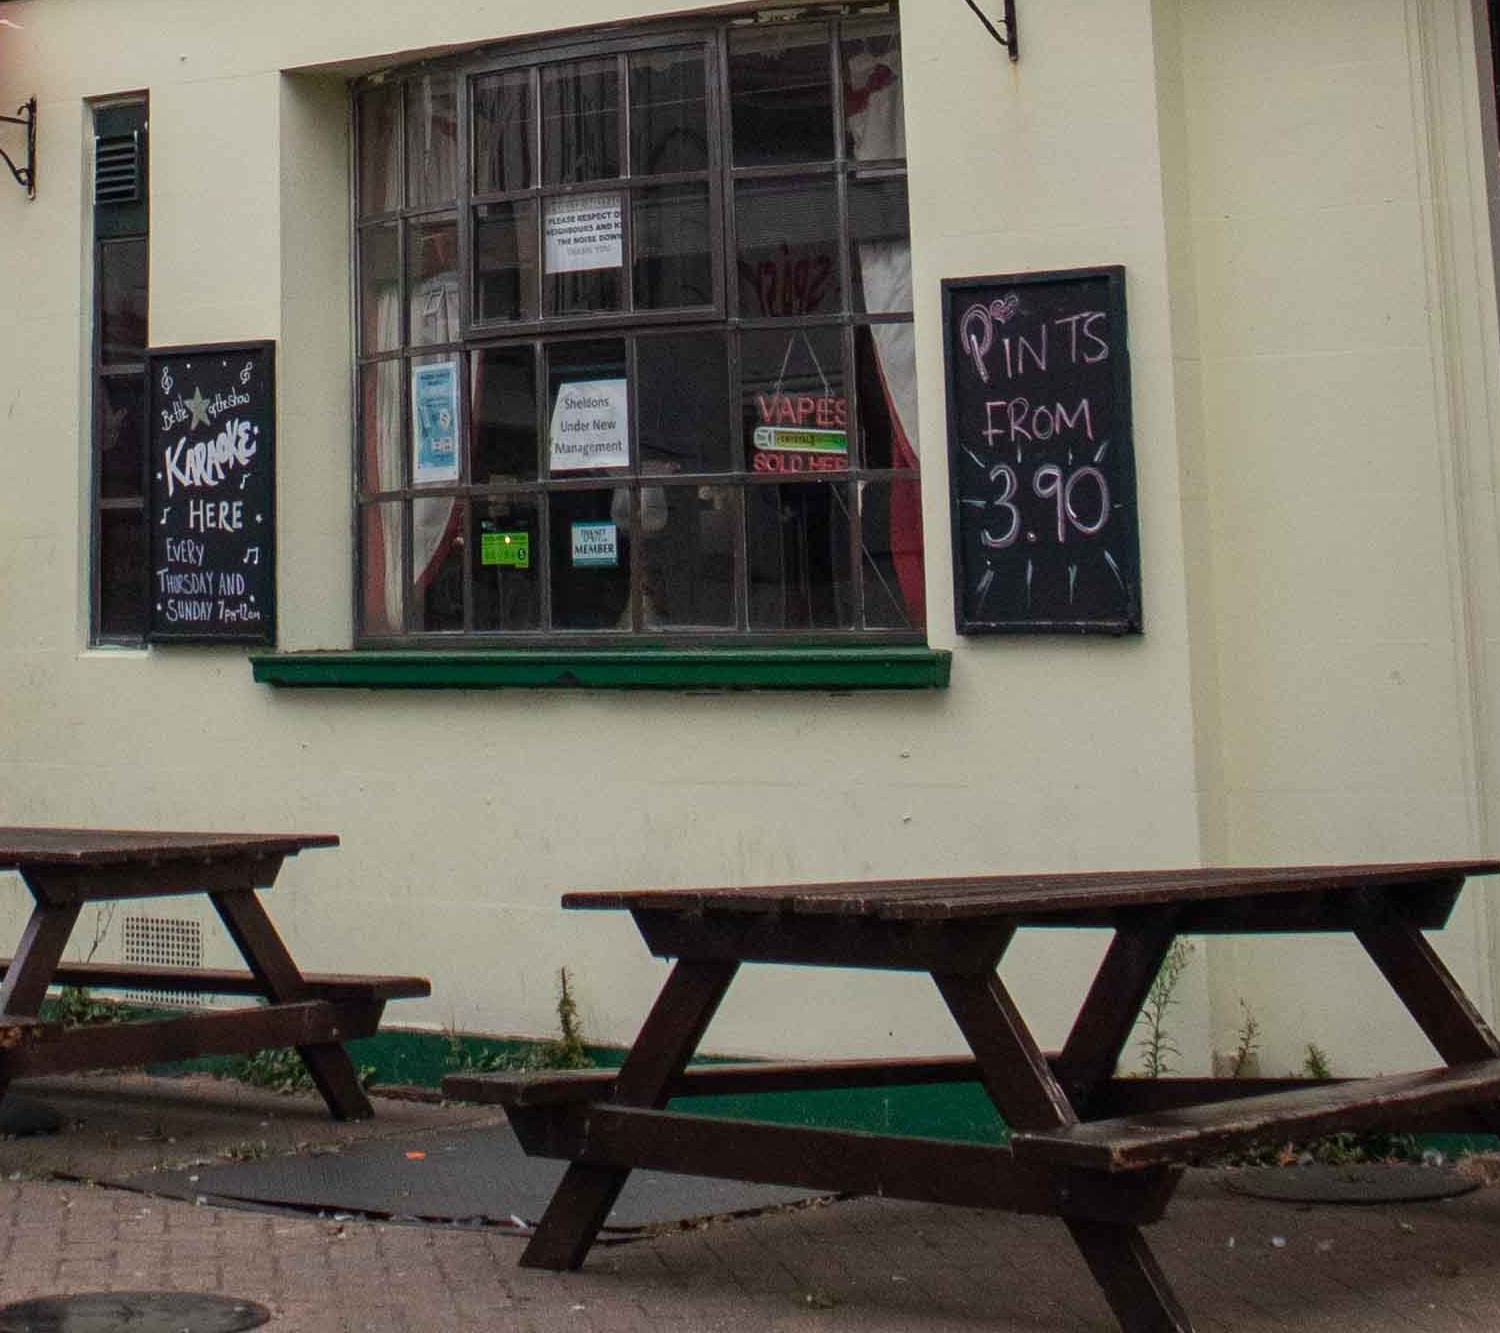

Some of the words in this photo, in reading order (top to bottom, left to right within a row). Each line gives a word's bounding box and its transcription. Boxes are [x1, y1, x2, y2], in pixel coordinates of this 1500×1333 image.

[960, 297, 1109, 382] PINTS
[563, 396, 609, 410] Sheldons
[759, 395, 847, 426] VAPES
[560, 420, 590, 432] Under
[593, 419, 617, 430] New
[982, 398, 1094, 444] FROM
[165, 417, 257, 498] KARAOKE
[554, 440, 623, 456] Management
[189, 499, 244, 533] HERE
[980, 463, 1111, 548] 3.90
[166, 537, 205, 566] EVERY
[156, 567, 214, 596] THURSDAY
[219, 572, 245, 596] AND
[166, 599, 213, 622] SUNDAY
